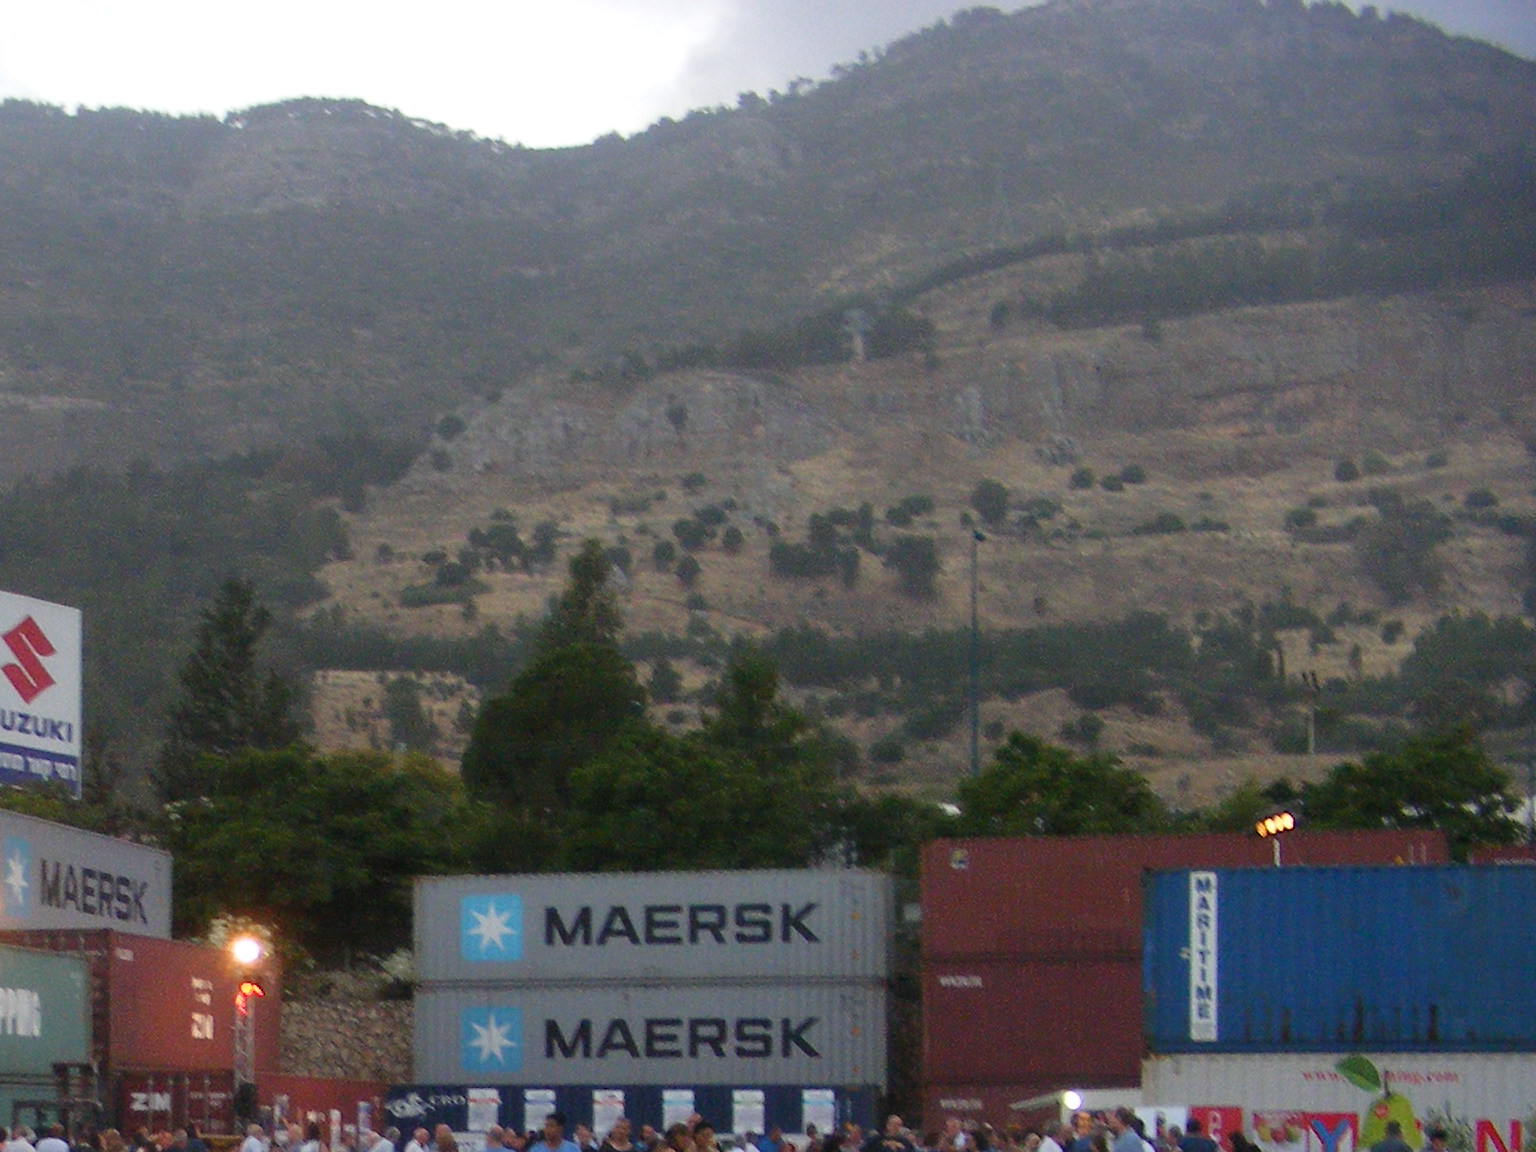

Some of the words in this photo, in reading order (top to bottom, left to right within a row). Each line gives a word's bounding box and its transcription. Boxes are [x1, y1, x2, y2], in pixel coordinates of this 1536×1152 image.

[40, 858, 149, 925] MAERSK
[544, 902, 820, 945] MAERSK
[1194, 875, 1213, 1020] MARITIME
[544, 1016, 822, 1058] MAERSK
